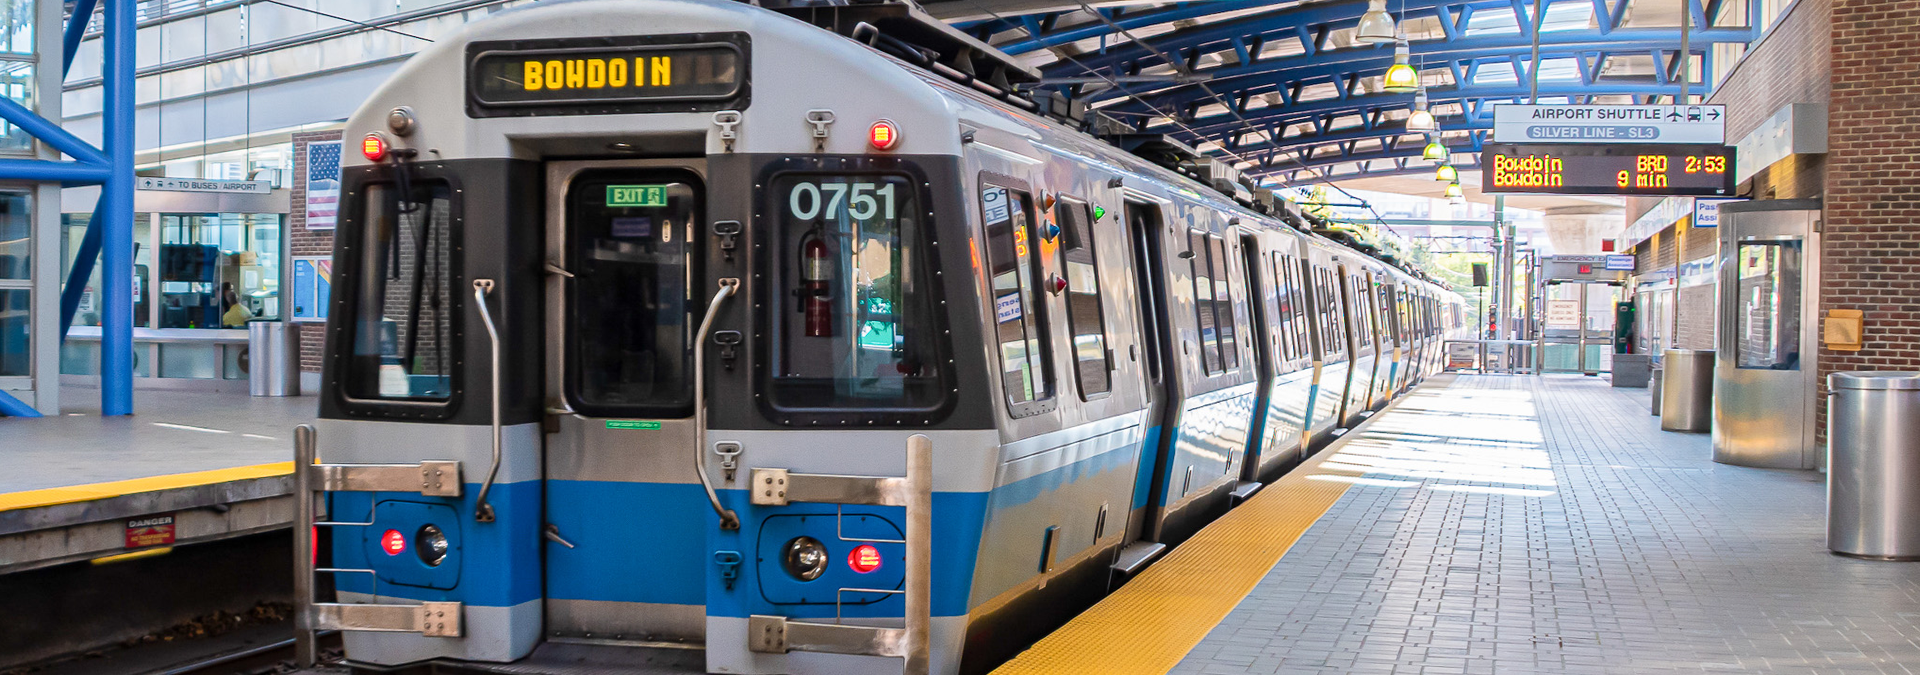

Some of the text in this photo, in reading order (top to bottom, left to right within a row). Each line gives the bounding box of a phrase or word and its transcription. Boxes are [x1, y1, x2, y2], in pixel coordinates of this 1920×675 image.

[524, 56, 671, 91] BOWDOIN
[1532, 108, 1661, 119] AIRPORT SHUTTLE
[1532, 127, 1580, 138] SILVER
[1583, 127, 1615, 138] LINE
[1628, 127, 1654, 138] SL3
[1493, 154, 1726, 173] Bowdoin BRD 2:53
[192, 182, 218, 190] BUSES
[223, 182, 257, 191] AIRPORT
[1493, 170, 1668, 188] Bowdoin 9 min
[614, 188, 644, 203] EXIT
[789, 182, 895, 220] 0751
[129, 517, 172, 528] DANGER
